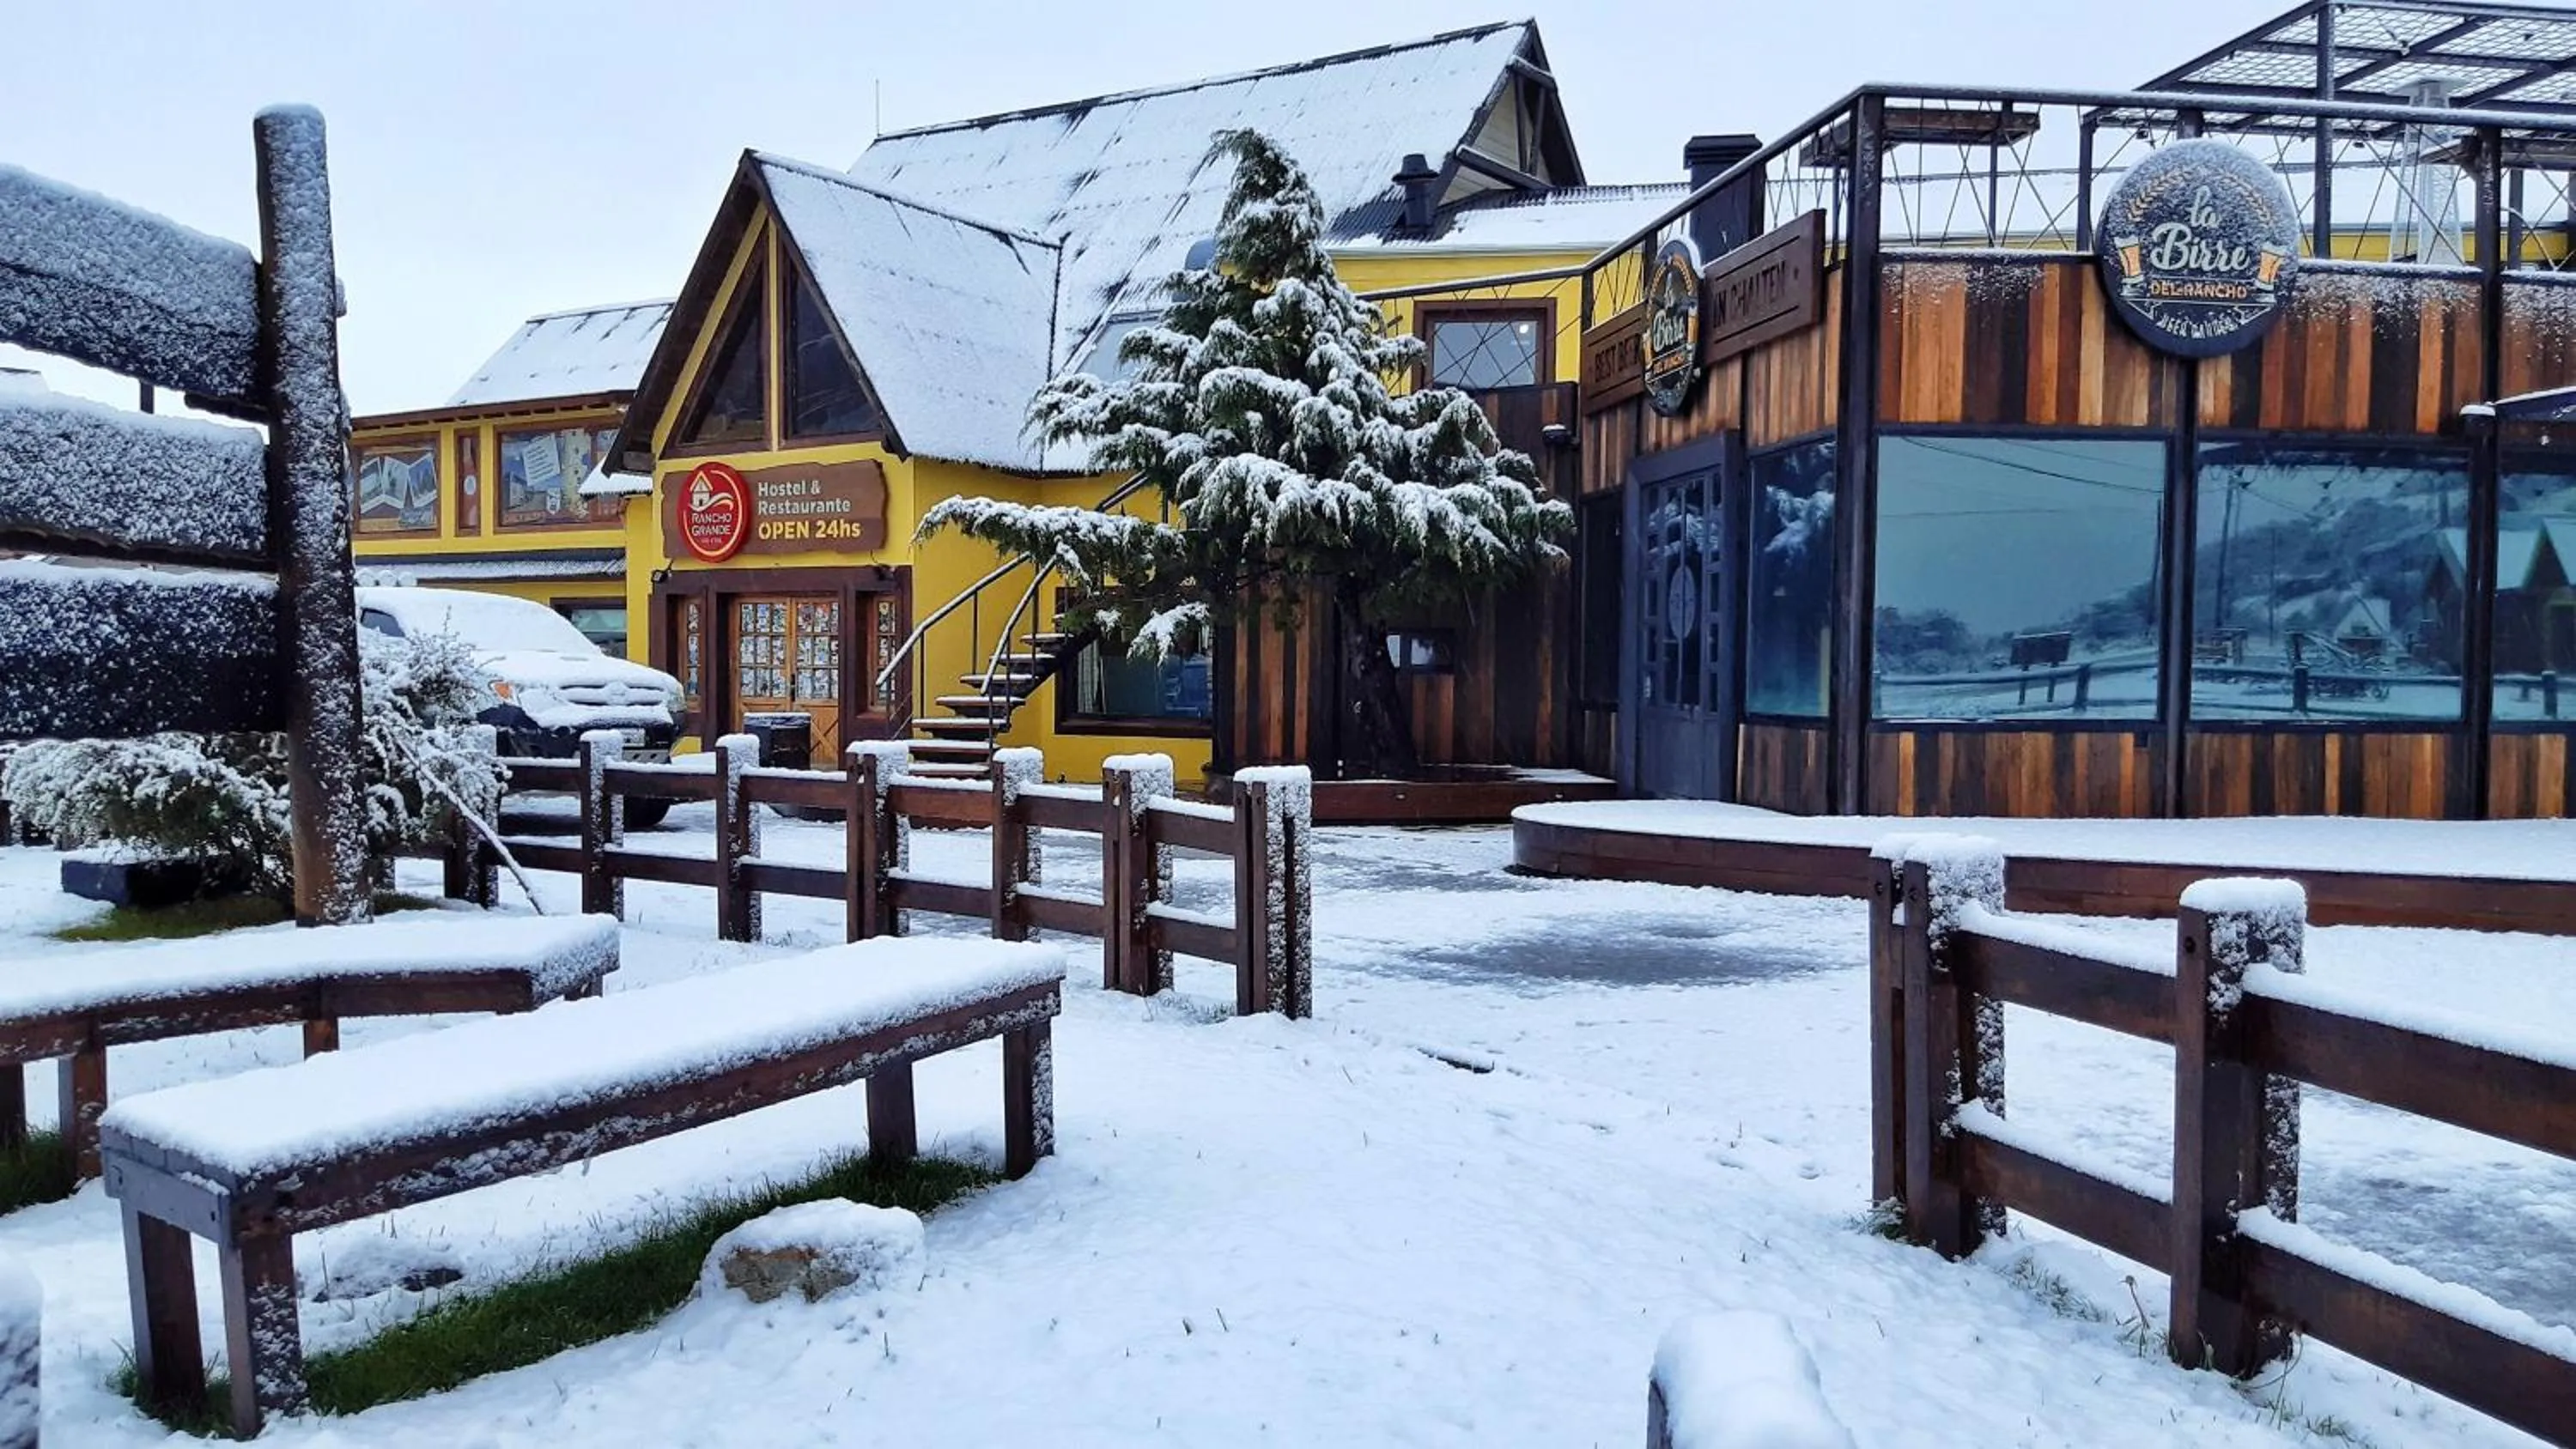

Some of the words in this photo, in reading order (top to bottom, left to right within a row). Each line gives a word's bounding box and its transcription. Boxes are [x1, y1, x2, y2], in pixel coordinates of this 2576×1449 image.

[2149, 222, 2249, 271] Birre
[758, 480, 806, 497] Hostel
[811, 480, 821, 494] &
[758, 498, 851, 515] Restaurante
[692, 512, 732, 524] RANCHO
[692, 524, 732, 537] GRANDE
[758, 520, 809, 540] OPEN
[815, 518, 861, 538] 24hs
